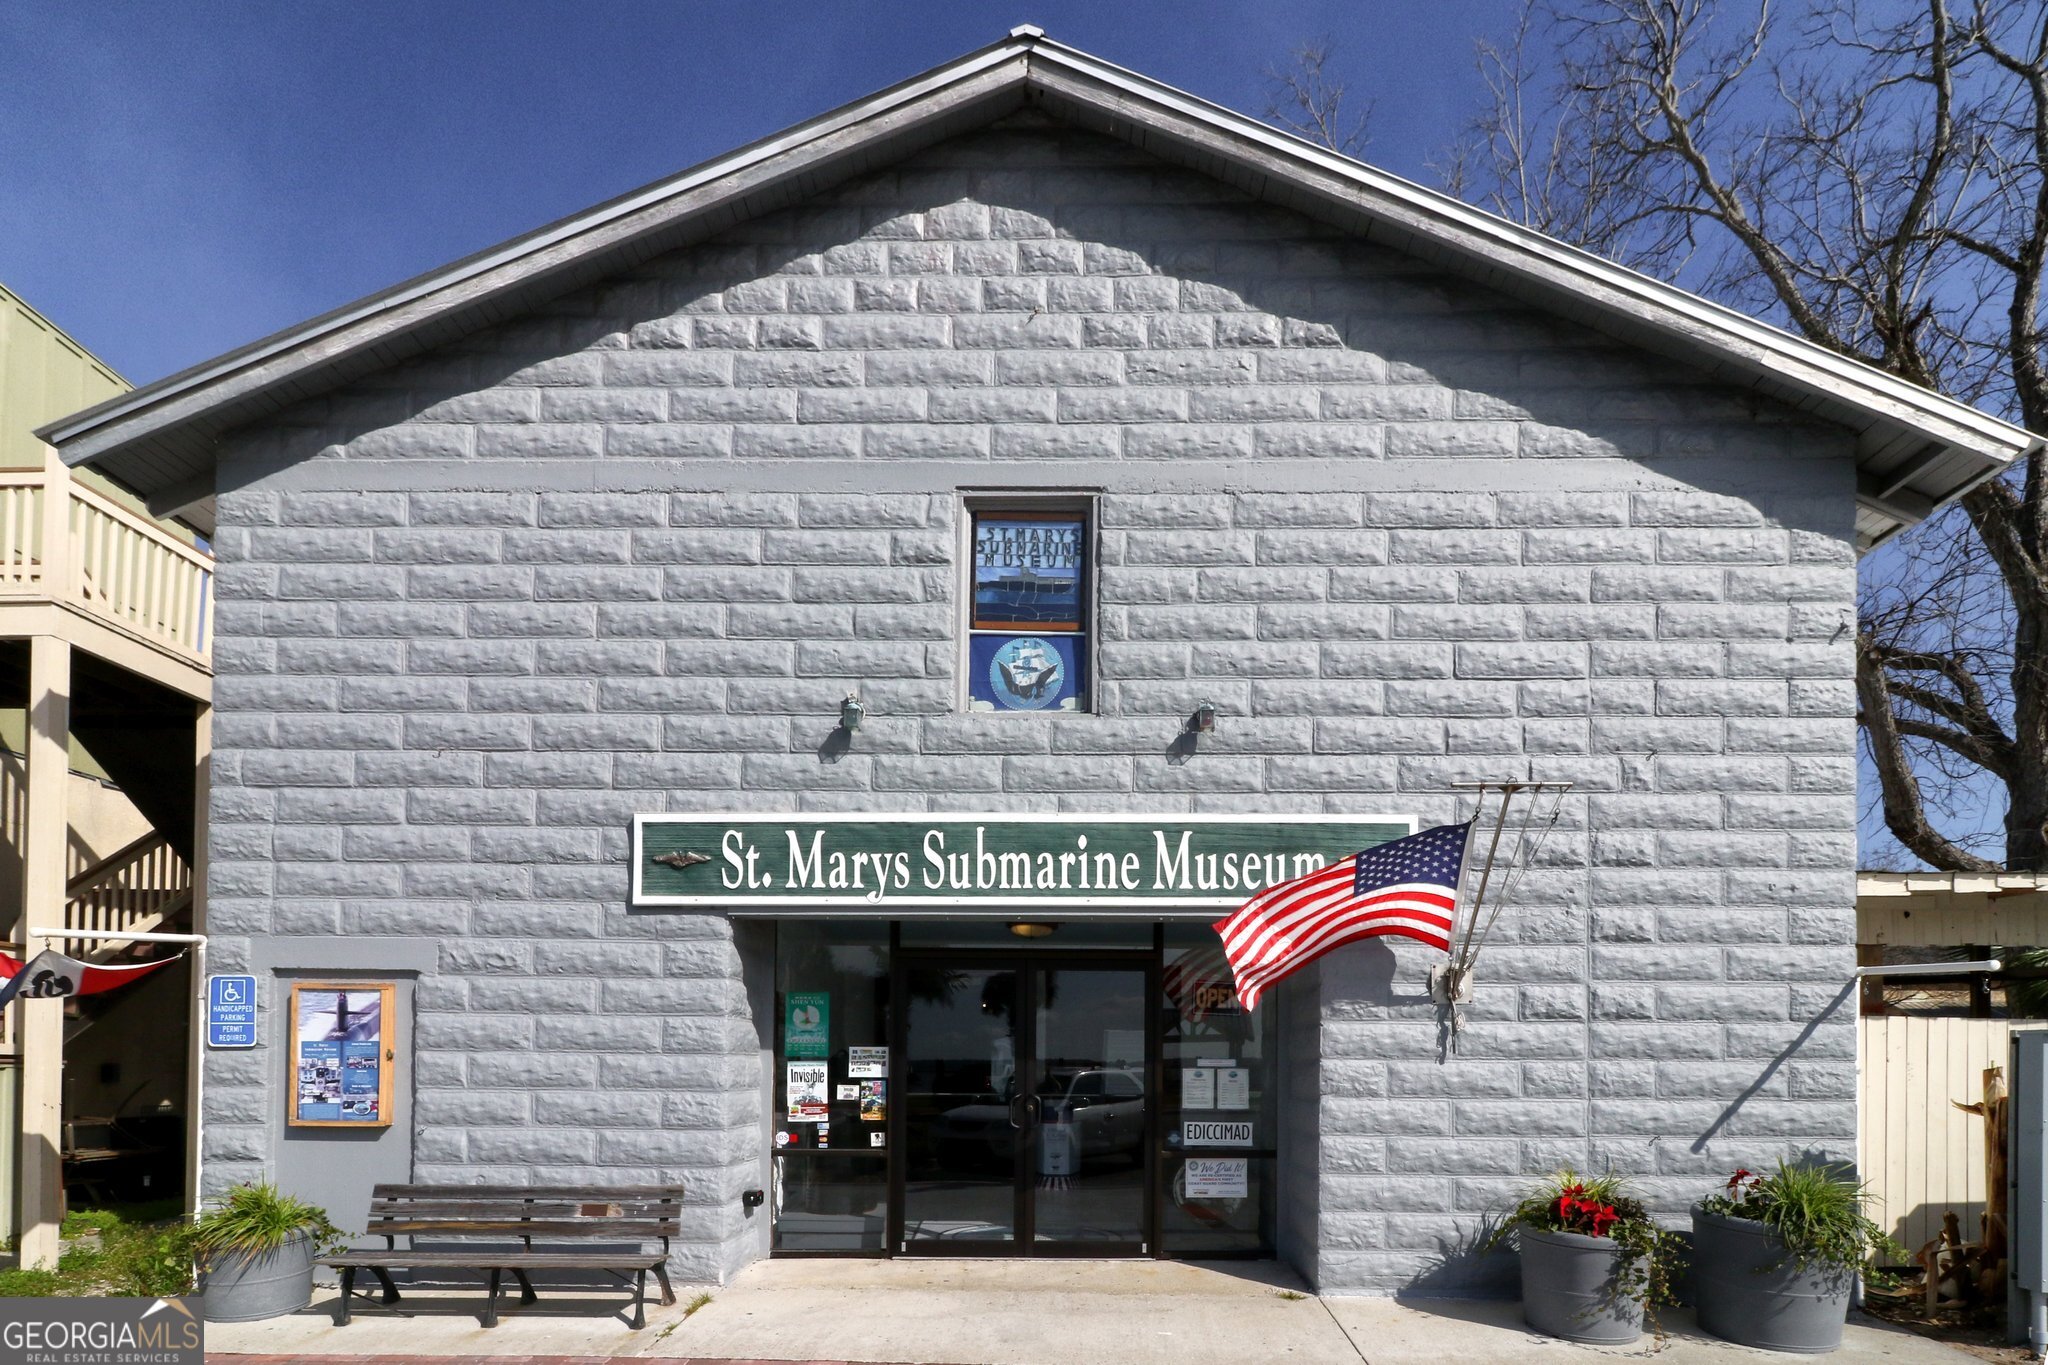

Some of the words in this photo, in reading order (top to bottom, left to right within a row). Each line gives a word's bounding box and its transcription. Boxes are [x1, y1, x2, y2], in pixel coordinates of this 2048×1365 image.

[1015, 528, 1081, 543] MARYS
[977, 540, 1082, 556] SUBMARINE
[985, 553, 1075, 568] MUSEUM
[722, 829, 773, 890] St.
[785, 829, 911, 904] Marys
[922, 826, 1142, 891] Submarine
[1152, 829, 1326, 891] Museum
[1195, 987, 1239, 1009] OPEN
[212, 1005, 254, 1013] HANDICAPPED
[222, 1025, 243, 1033] PERMIT
[218, 1034, 247, 1042] REQUIRED
[791, 1067, 825, 1084] Invisible
[1186, 1123, 1250, 1141] EDICCIMAD
[1200, 1162, 1215, 1173] We
[1215, 1161, 1232, 1174] Did
